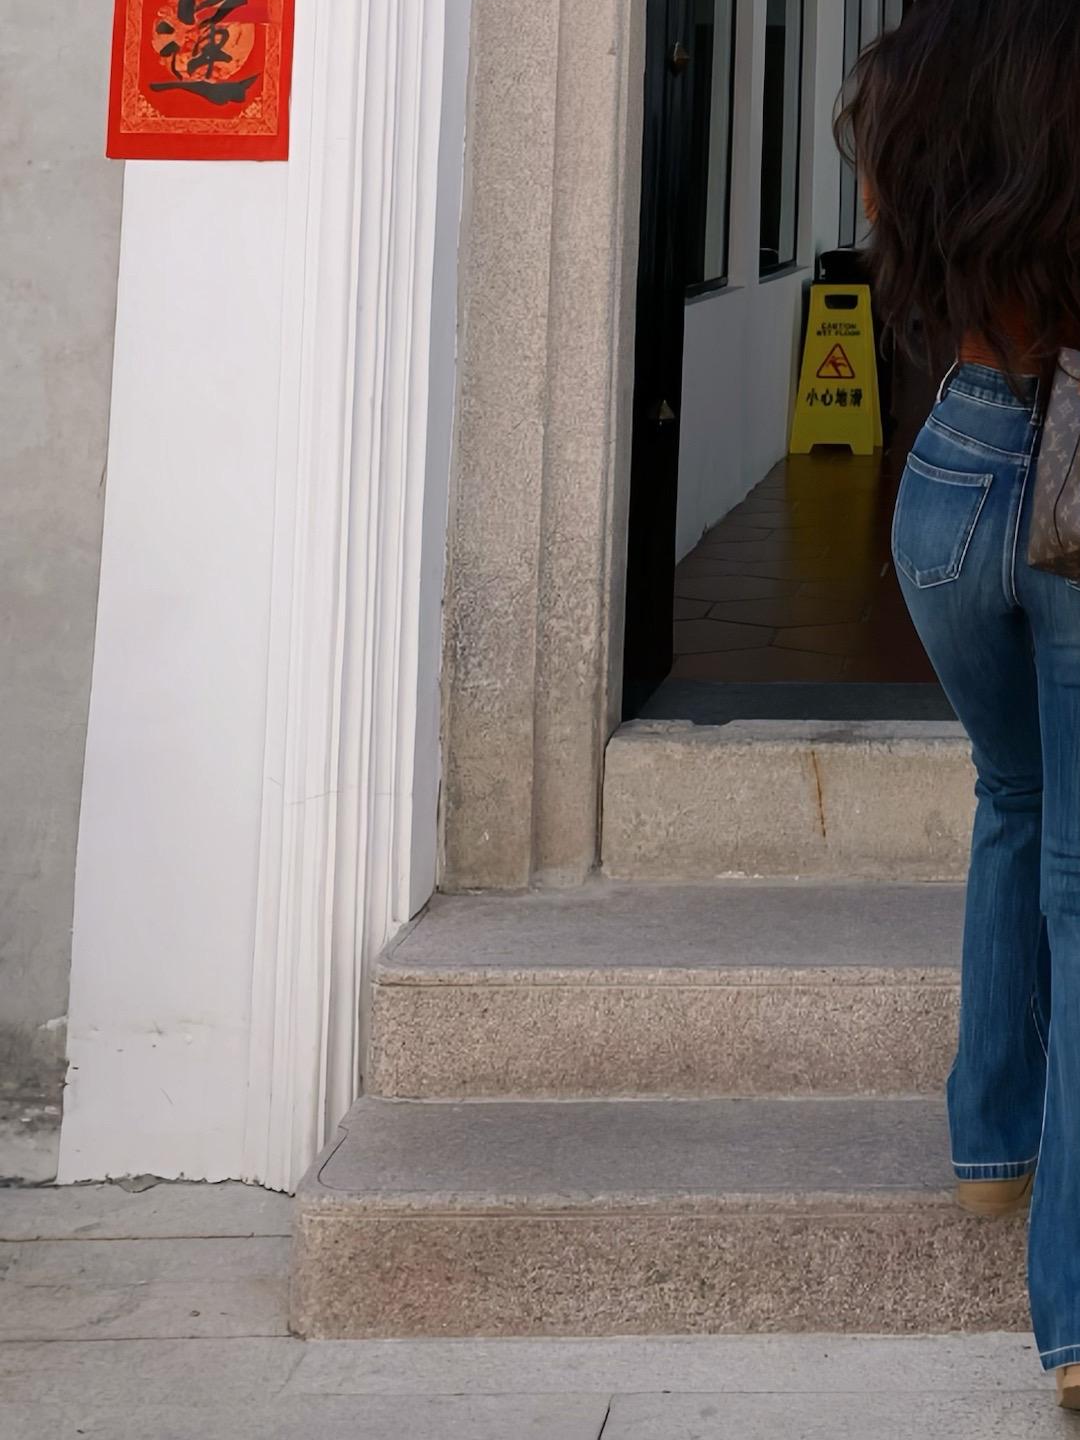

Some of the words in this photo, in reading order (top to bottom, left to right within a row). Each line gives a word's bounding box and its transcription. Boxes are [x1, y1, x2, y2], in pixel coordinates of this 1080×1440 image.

[821, 322, 857, 330] CAUTION
[835, 329, 861, 337] FLOOR
[806, 387, 863, 408] 小心地滑
